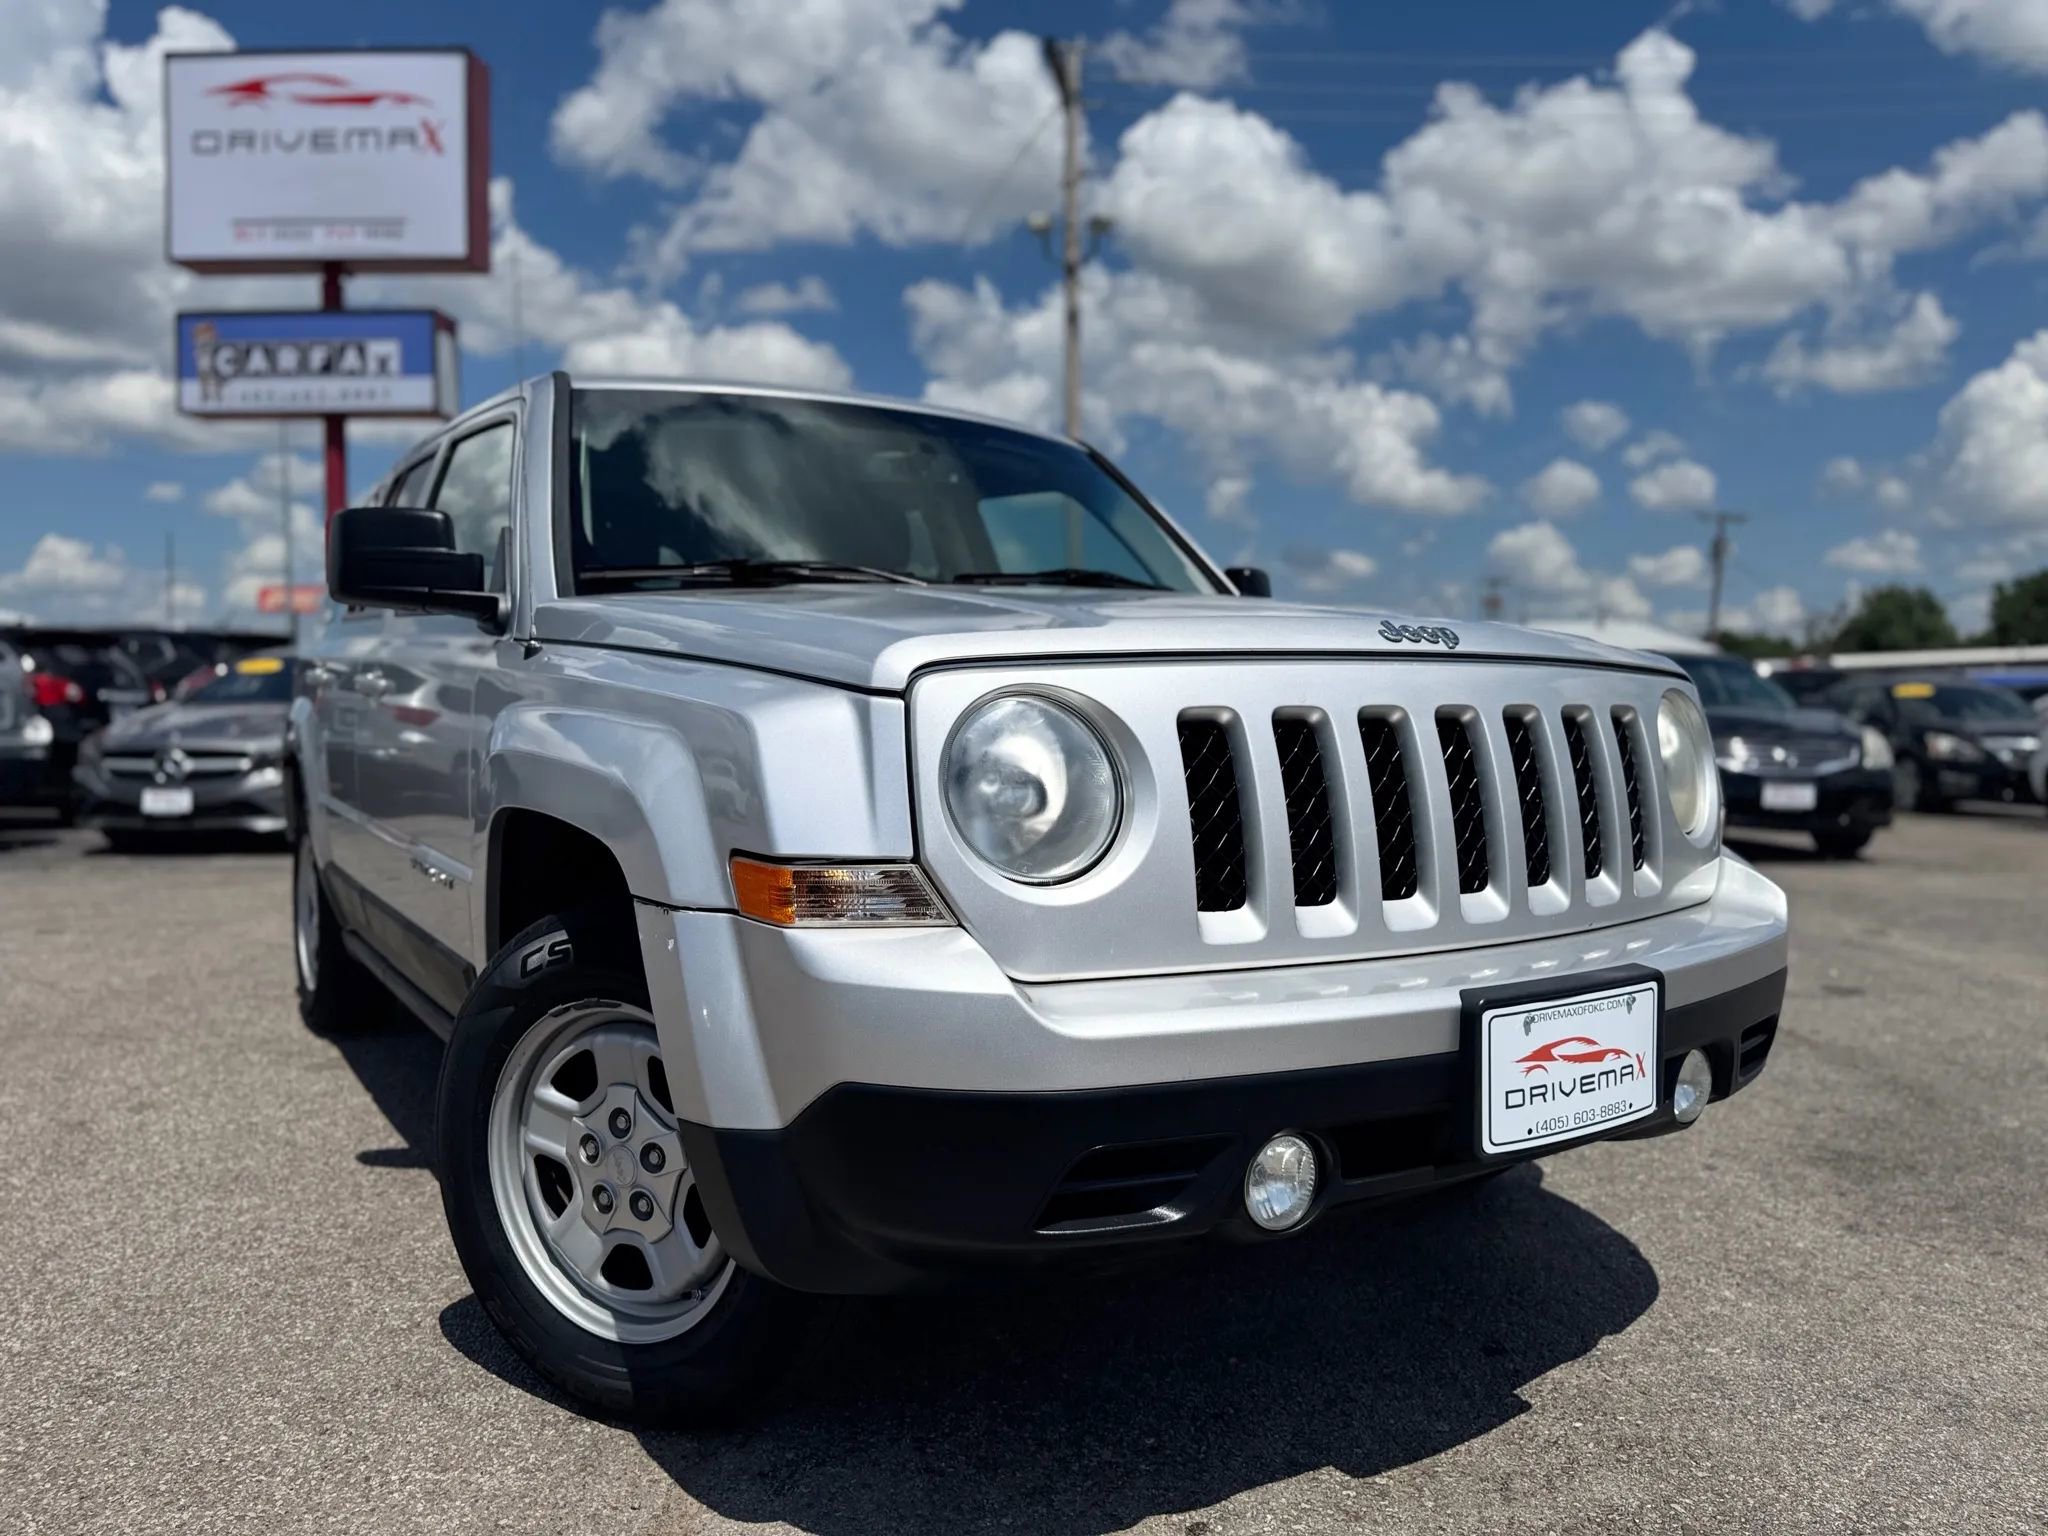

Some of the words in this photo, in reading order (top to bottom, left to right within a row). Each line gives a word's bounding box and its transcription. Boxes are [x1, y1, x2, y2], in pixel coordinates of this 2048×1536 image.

[190, 117, 446, 156] DRIVEMAX
[1378, 620, 1460, 649] Jeep
[1505, 1051, 1646, 1110] DRIVEMAX
[1535, 1114, 1569, 1134] (405)
[1573, 1100, 1627, 1125] 603-8883
